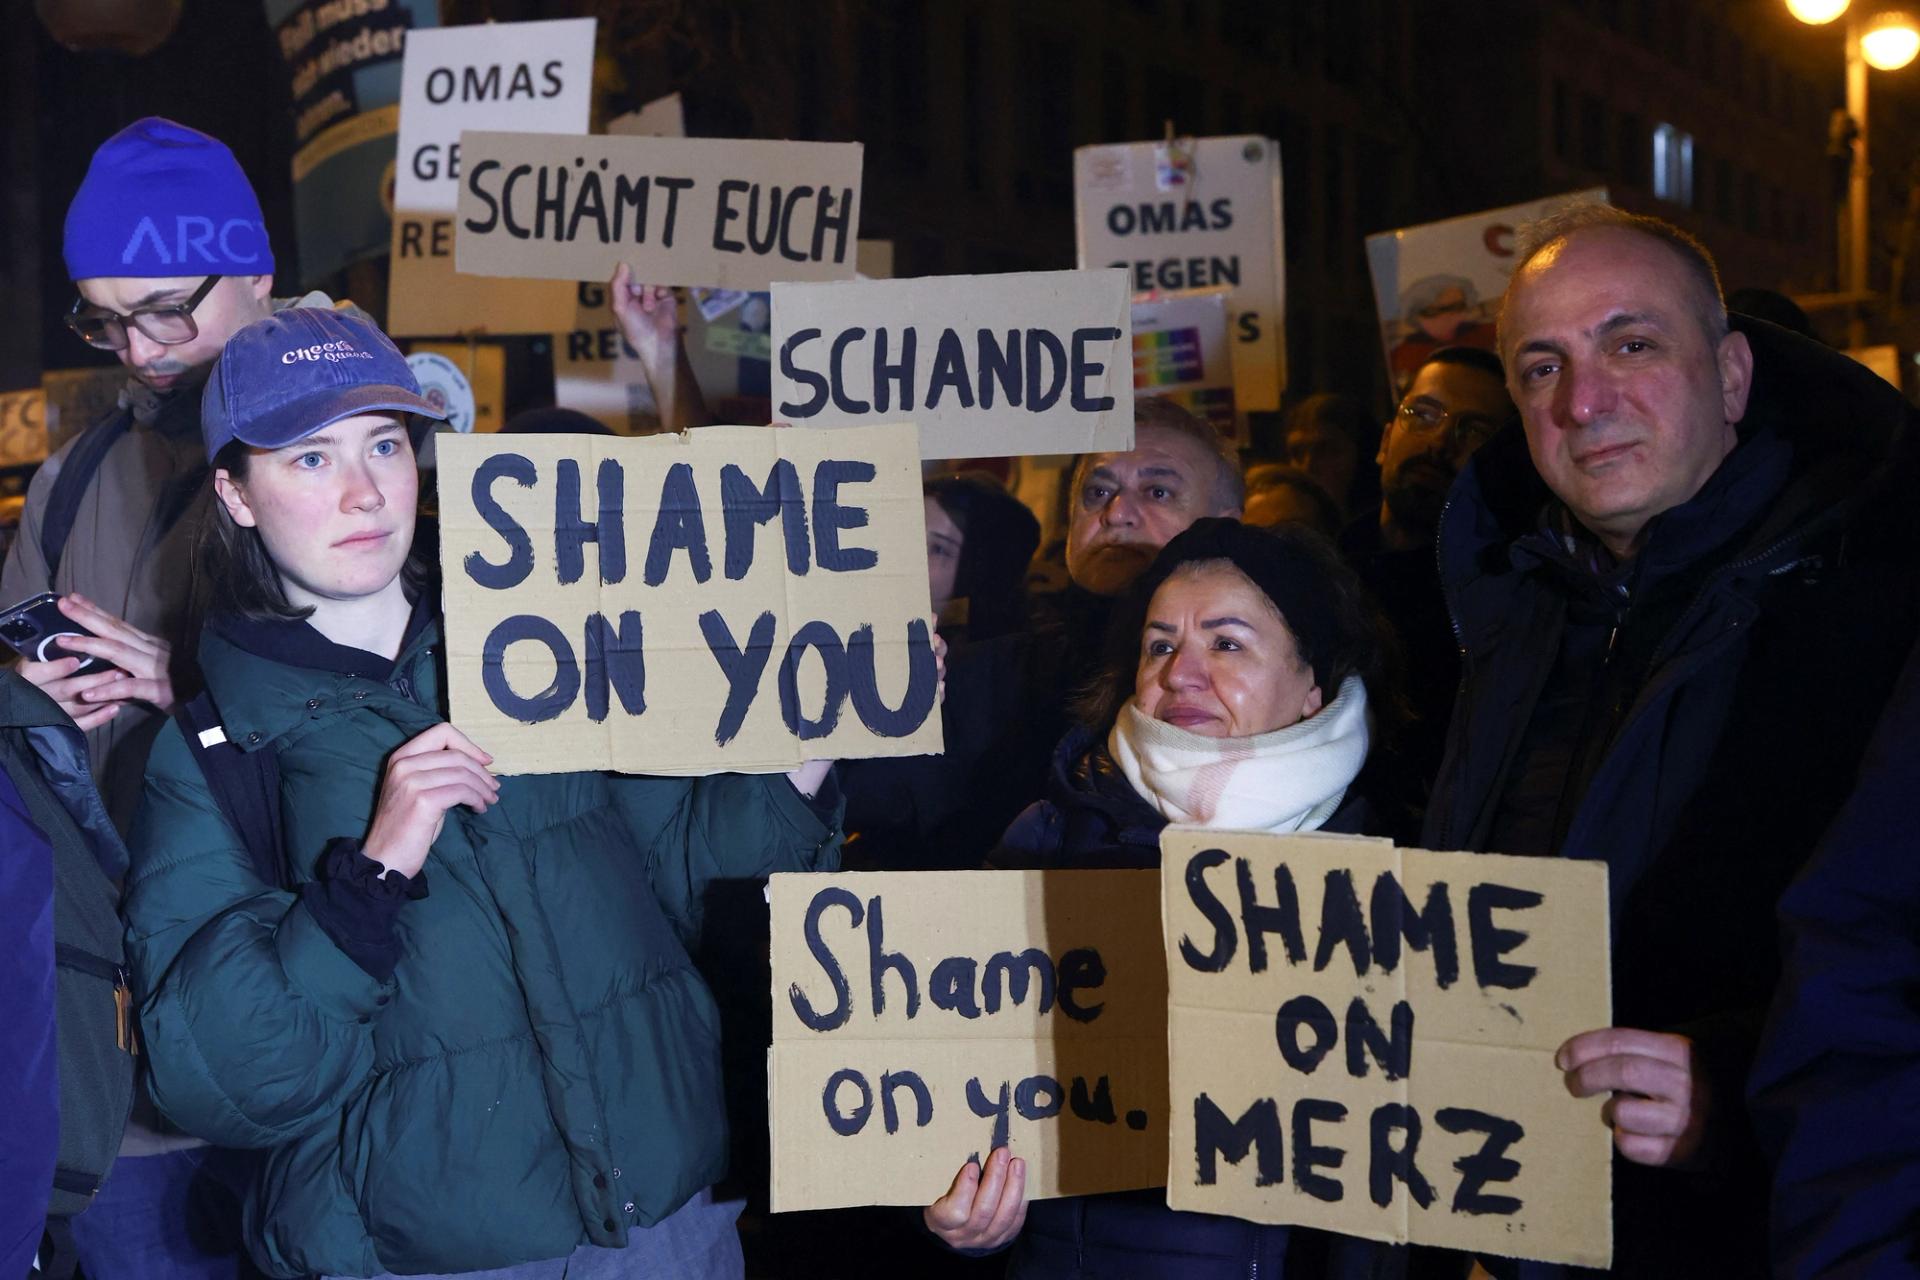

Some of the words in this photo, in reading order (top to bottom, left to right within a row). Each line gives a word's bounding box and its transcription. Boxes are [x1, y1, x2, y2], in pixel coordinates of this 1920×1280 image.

[424, 61, 564, 104] OMAS
[121, 214, 263, 264] ARC
[464, 157, 695, 248] SCHÄMT
[712, 179, 853, 264] EUCH
[1106, 197, 1234, 237] OMAS
[1107, 254, 1241, 292] EGEN
[779, 326, 1122, 418] SCHANDE
[463, 453, 878, 591] SHAME
[481, 609, 647, 725] ON
[698, 608, 938, 748] YOU
[788, 886, 1108, 1033] Shame
[1178, 848, 1545, 991] SHAME
[1275, 995, 1415, 1082] ON
[821, 1067, 934, 1137] on
[965, 1073, 1148, 1187] you.
[1194, 1091, 1526, 1216] MERZ
